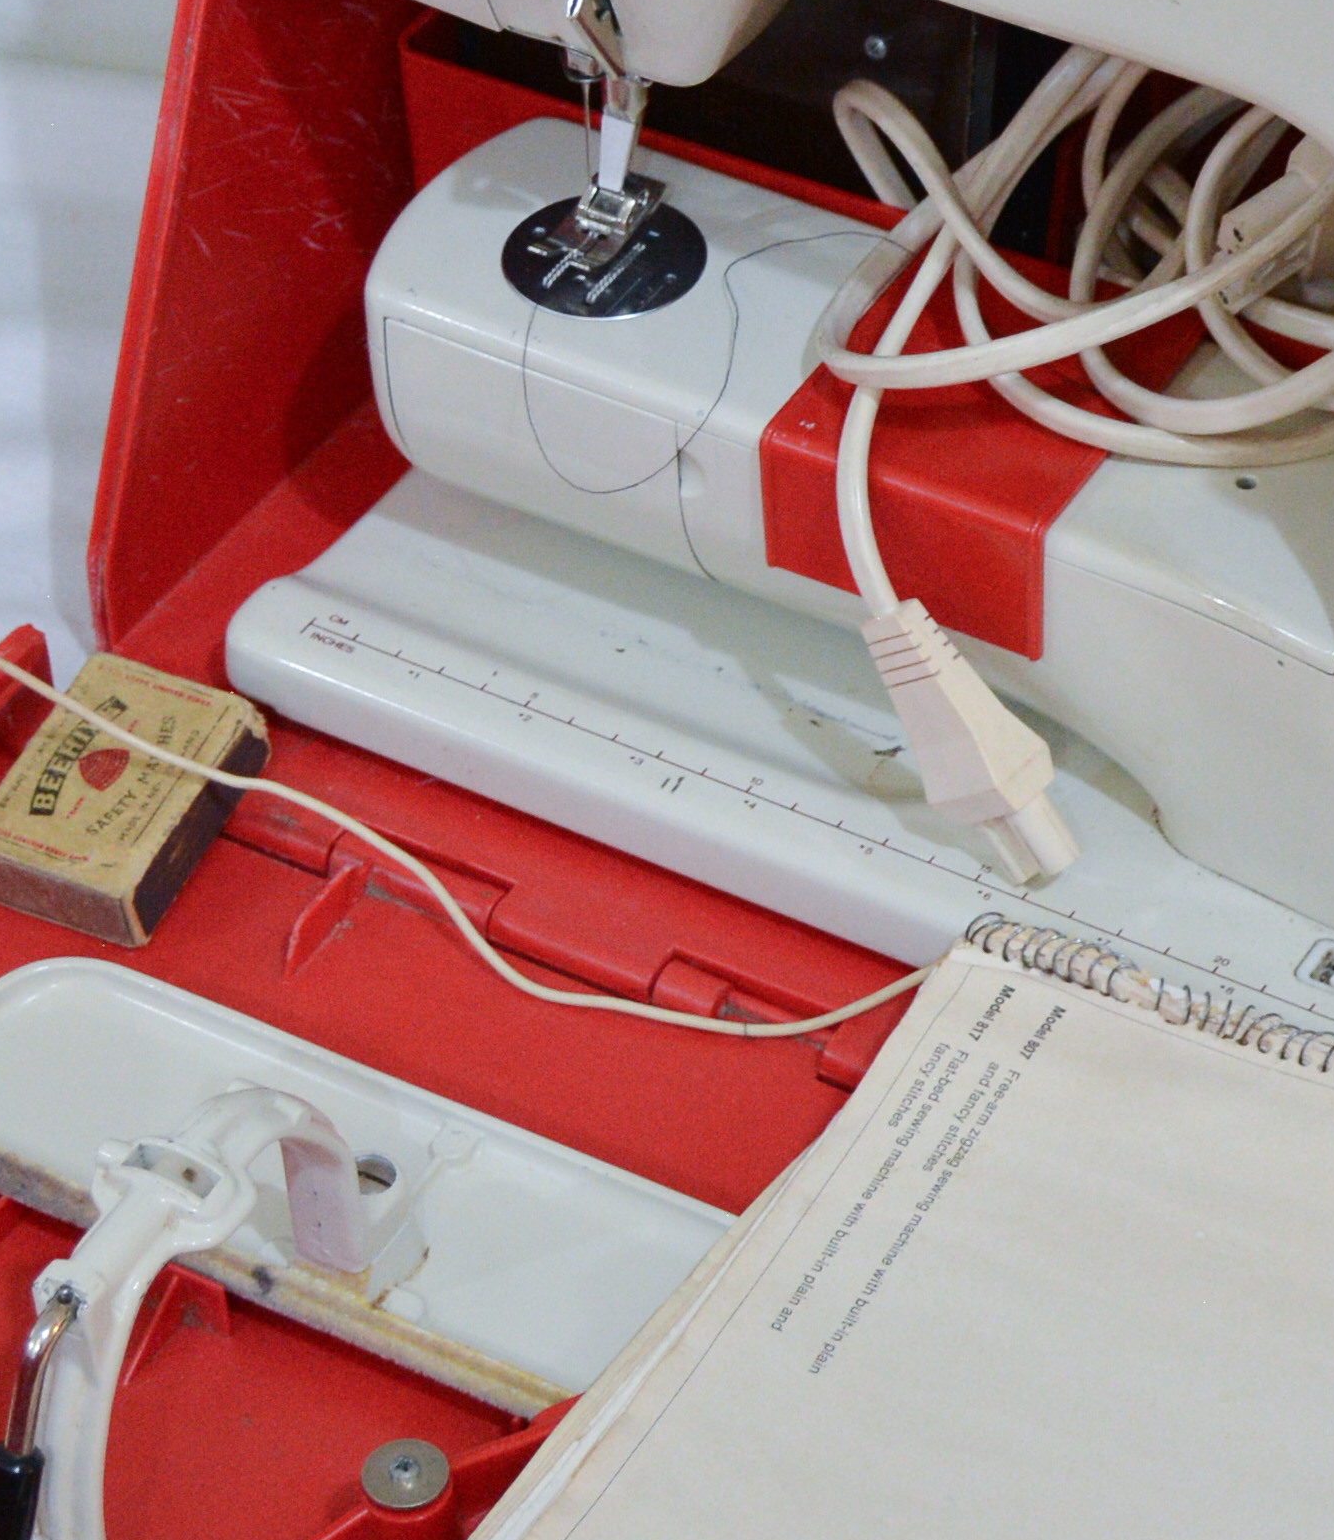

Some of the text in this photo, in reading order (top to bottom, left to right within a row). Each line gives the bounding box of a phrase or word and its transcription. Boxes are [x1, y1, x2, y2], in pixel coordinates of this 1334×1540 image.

[309, 631, 356, 655] INCHES
[32, 700, 122, 809] BEEHIE
[85, 790, 137, 837] SAFETY
[137, 715, 177, 785] MAHES
[886, 1041, 951, 1128] fancy stitches
[921, 1060, 1000, 1172] and fancy stitches
[769, 983, 1016, 1332] Model 817 Flat-bed sewing machine with built-in plain and
[807, 1004, 1067, 1375] Model 807 Free-arm zigzag sewing machine with built-in plain
